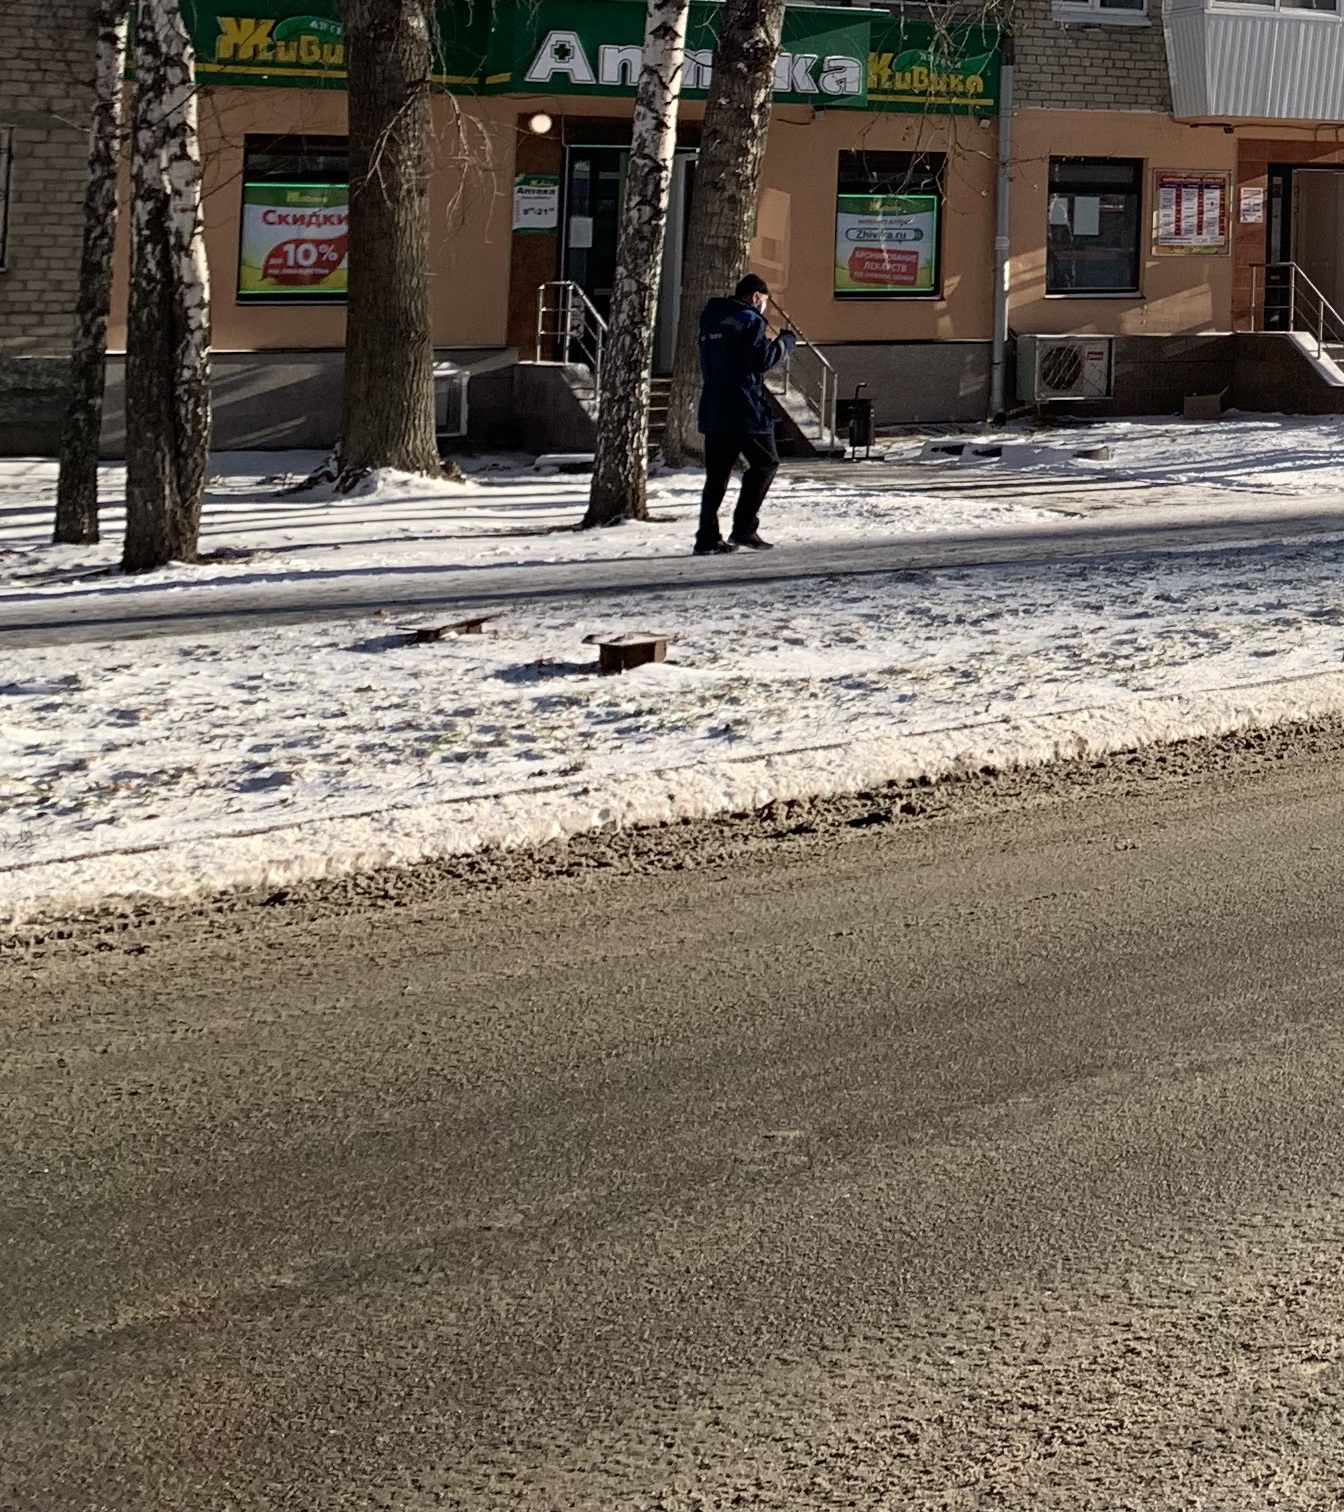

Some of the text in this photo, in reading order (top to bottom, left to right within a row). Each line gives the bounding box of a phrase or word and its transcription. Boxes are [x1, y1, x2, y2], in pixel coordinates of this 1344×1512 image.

[215, 16, 345, 64] Живи
[524, 30, 863, 95] Апка
[262, 209, 349, 228] Скидки
